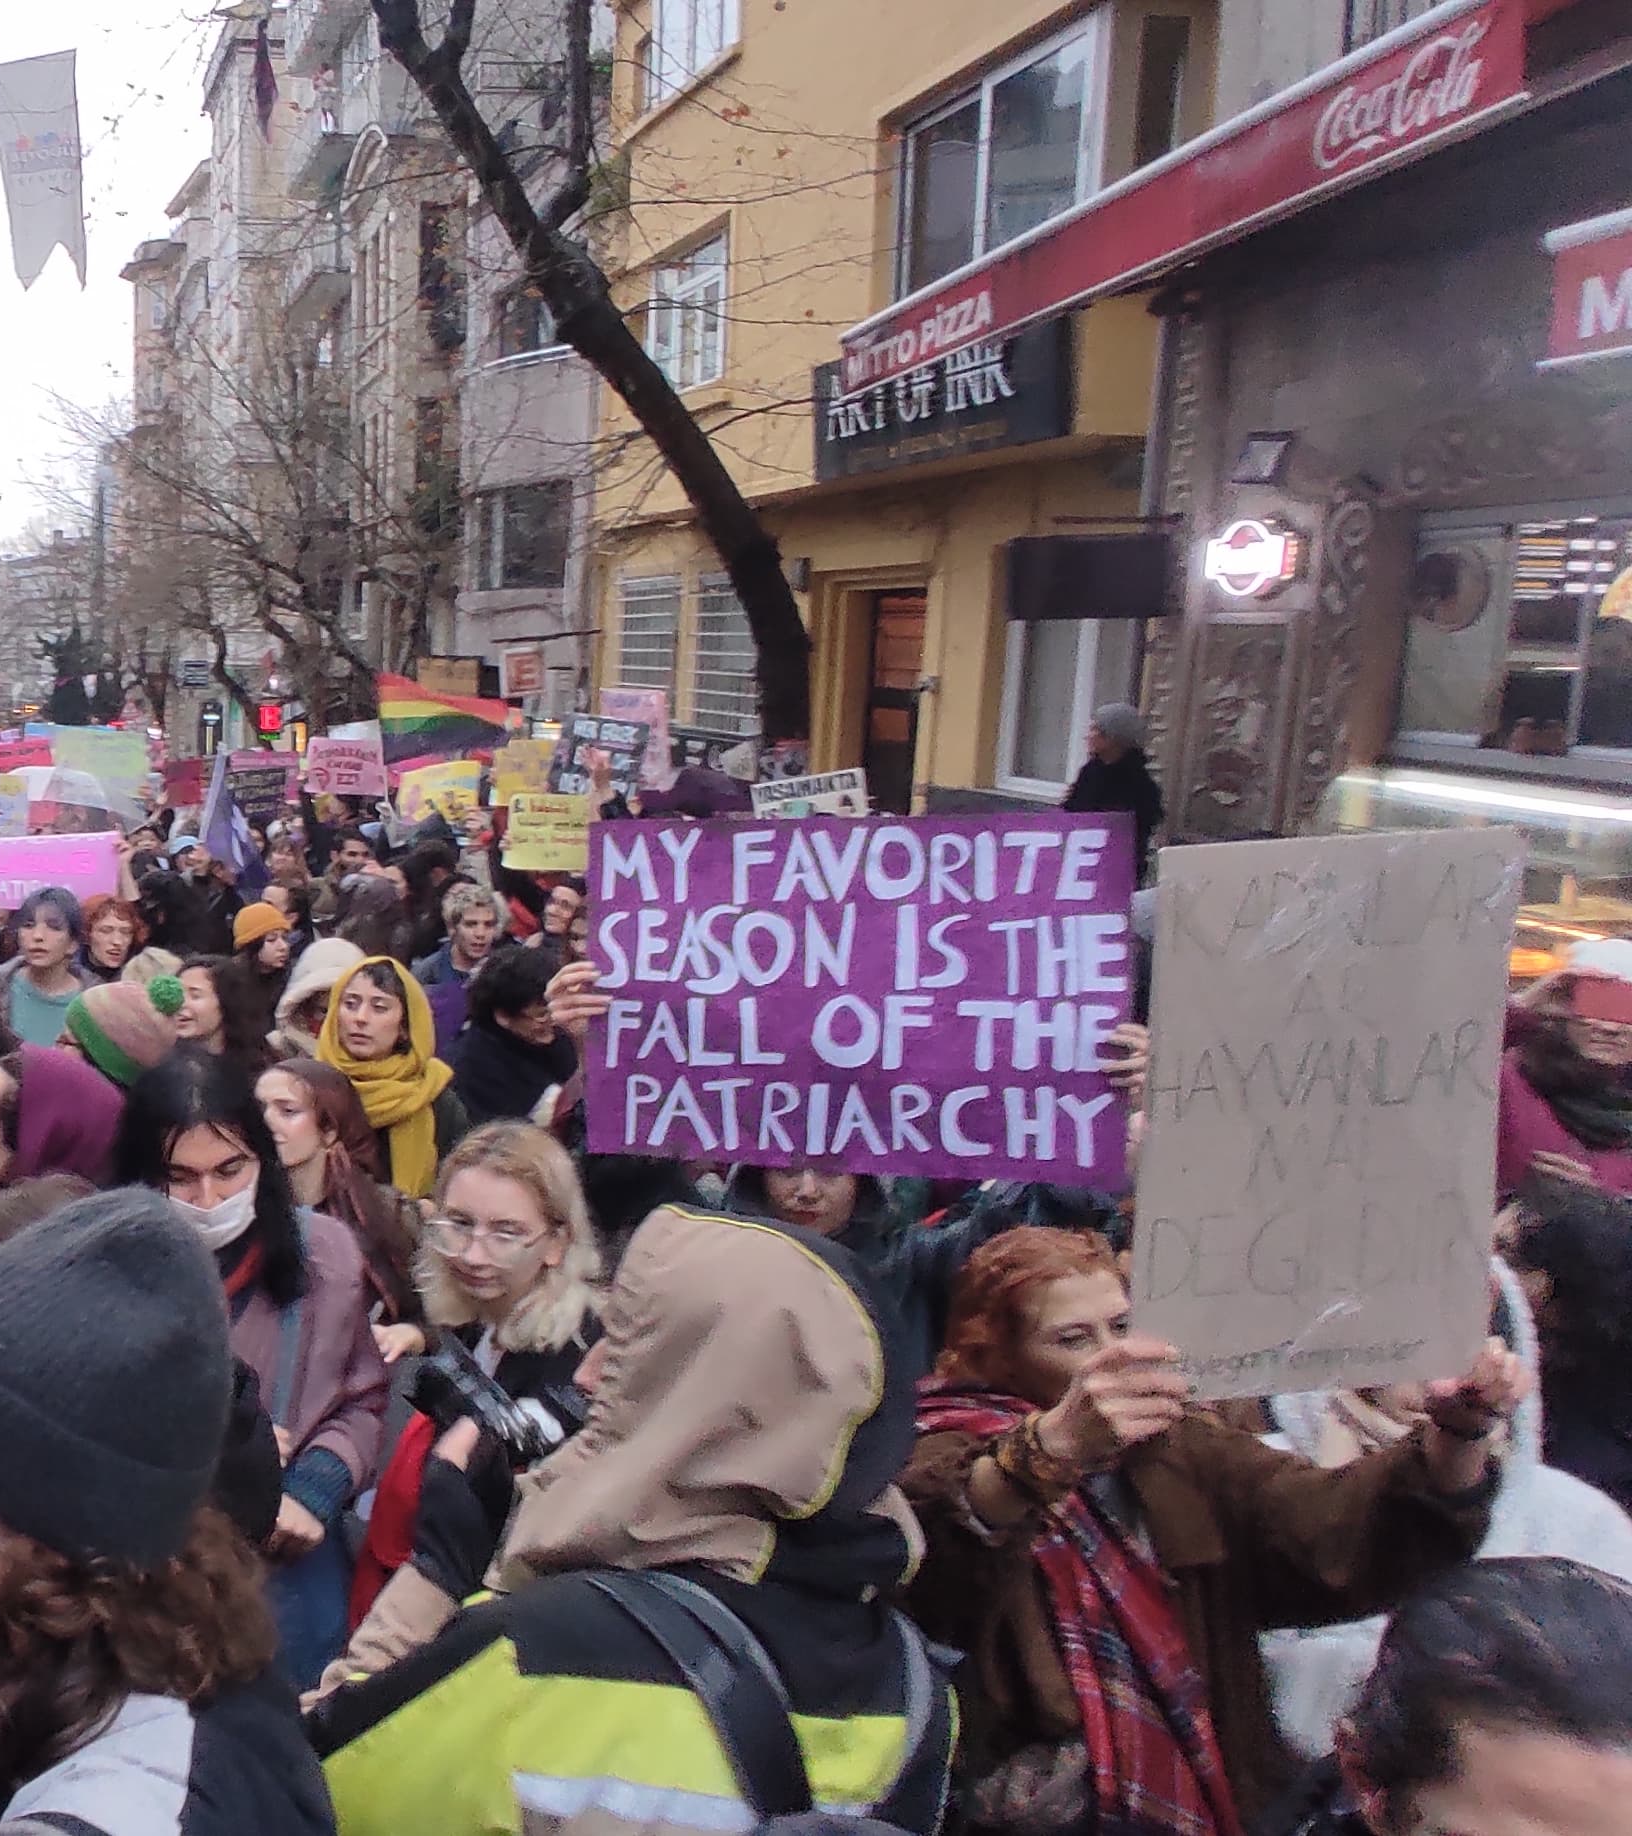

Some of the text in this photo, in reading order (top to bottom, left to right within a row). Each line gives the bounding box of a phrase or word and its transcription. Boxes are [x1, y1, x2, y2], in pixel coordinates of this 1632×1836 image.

[601, 825, 1107, 904] MY FAVORITE
[597, 903, 1128, 998] SEASON IS THE
[604, 994, 1119, 1072] FALL OF THE
[624, 1073, 1116, 1168] PATRIARCHY
